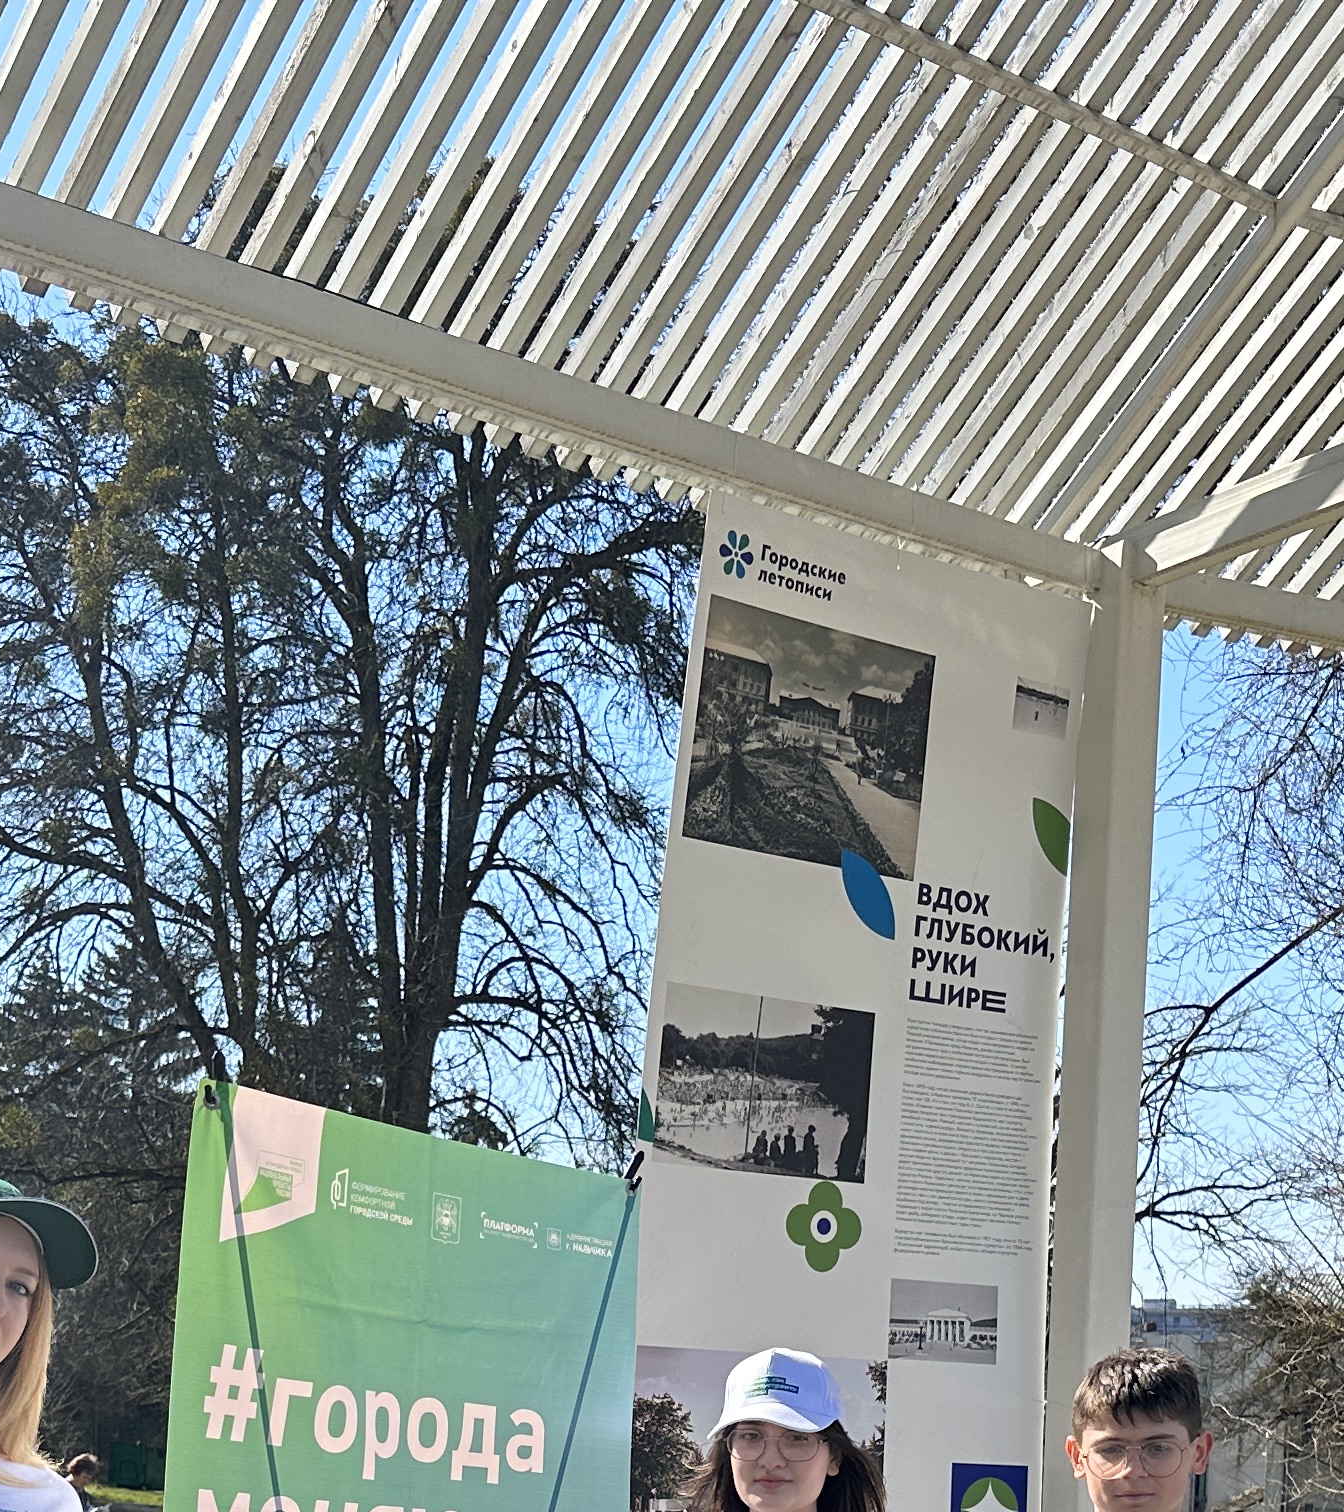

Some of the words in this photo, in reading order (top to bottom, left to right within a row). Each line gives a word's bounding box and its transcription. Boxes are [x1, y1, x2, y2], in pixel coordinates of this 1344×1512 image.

[761, 544, 846, 584] Городские
[757, 569, 832, 601] летописи
[917, 883, 990, 917] ВДОХ
[914, 915, 1055, 963] ГЛУБОКИЙ,
[911, 947, 977, 978] РУКИ
[909, 979, 1007, 1013] ШИРЕ
[484, 1218, 534, 1237] ПЛАТФОРМА
[204, 1344, 545, 1484] #города
